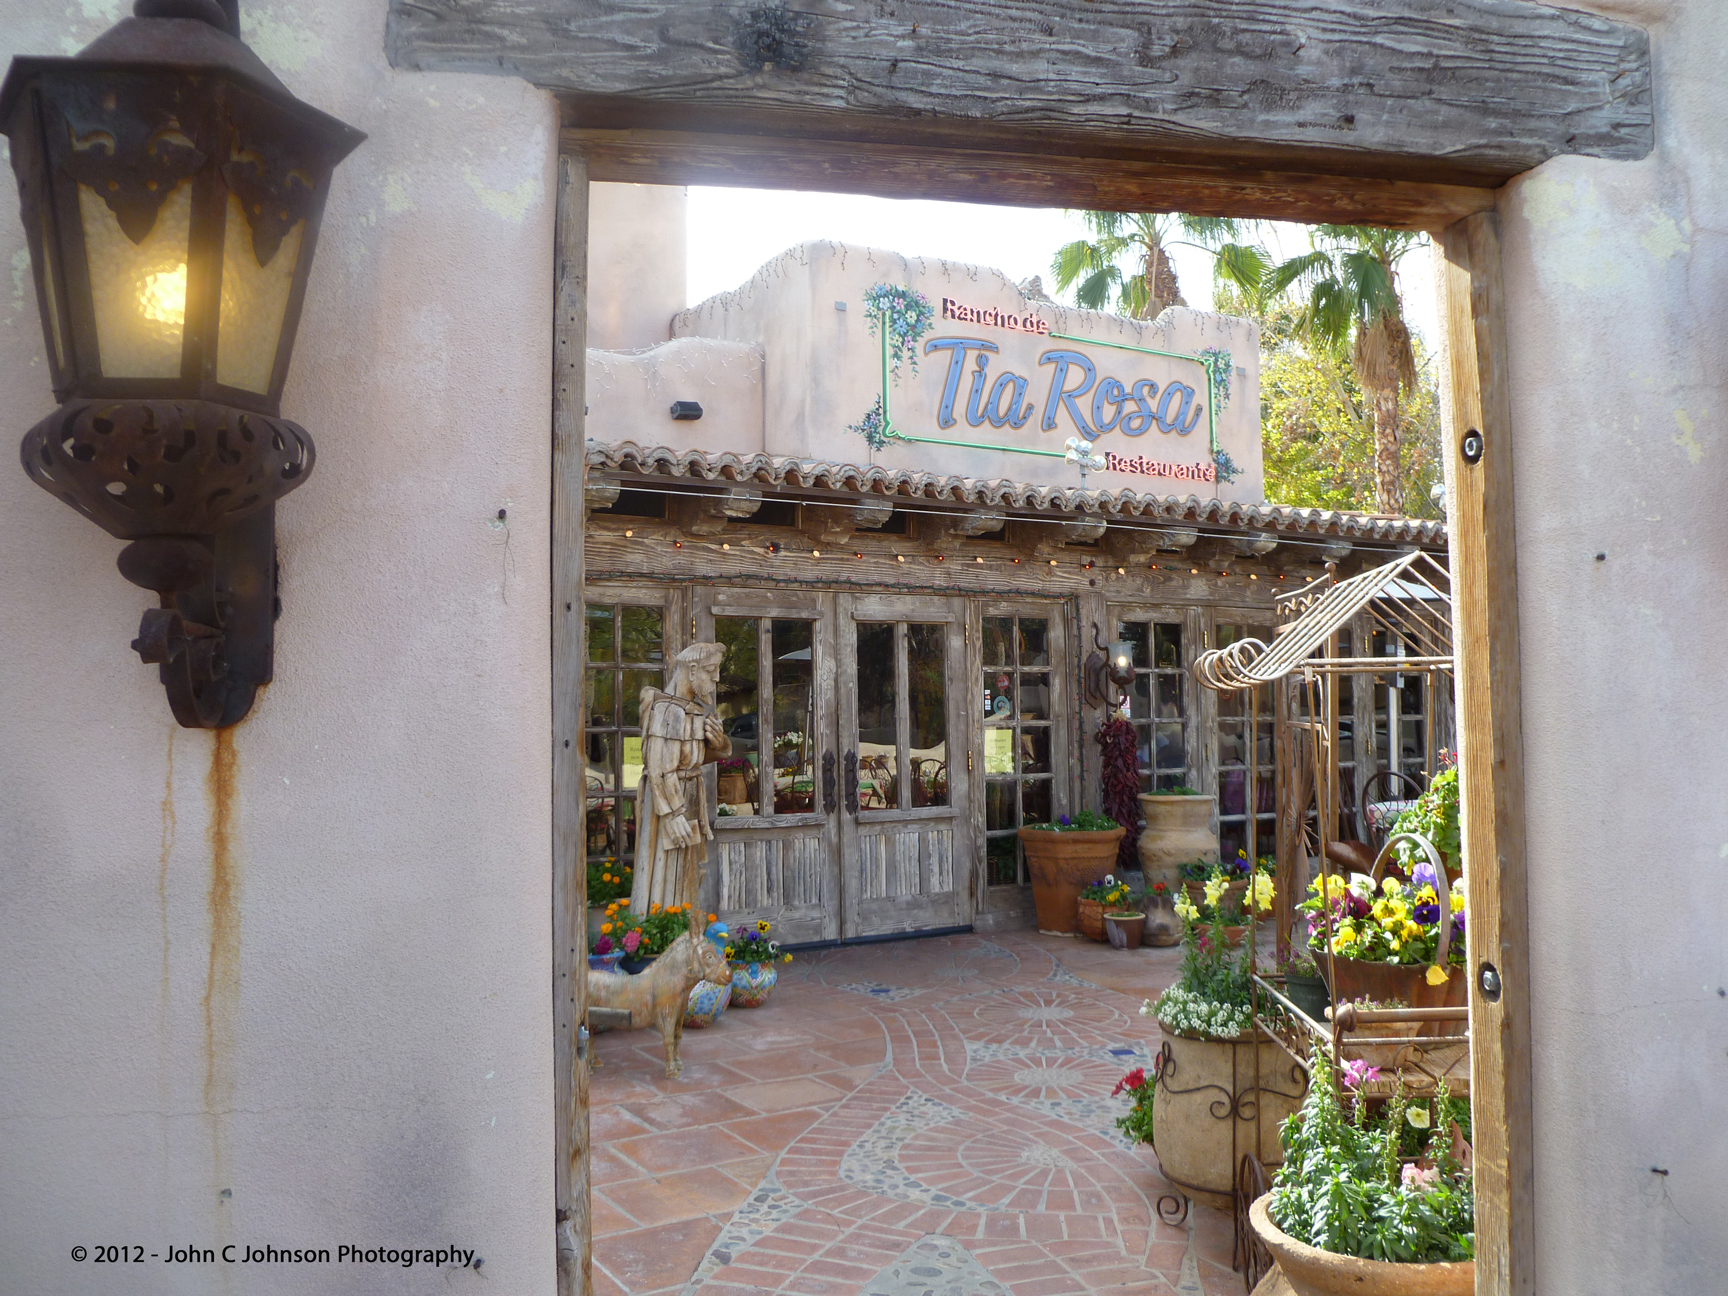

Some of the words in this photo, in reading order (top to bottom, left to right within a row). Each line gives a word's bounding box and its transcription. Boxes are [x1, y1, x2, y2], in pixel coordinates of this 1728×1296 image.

[942, 297, 1020, 330] Rancho
[1022, 313, 1049, 335] de
[924, 336, 1035, 430] Tia
[1038, 349, 1204, 442] Rosa
